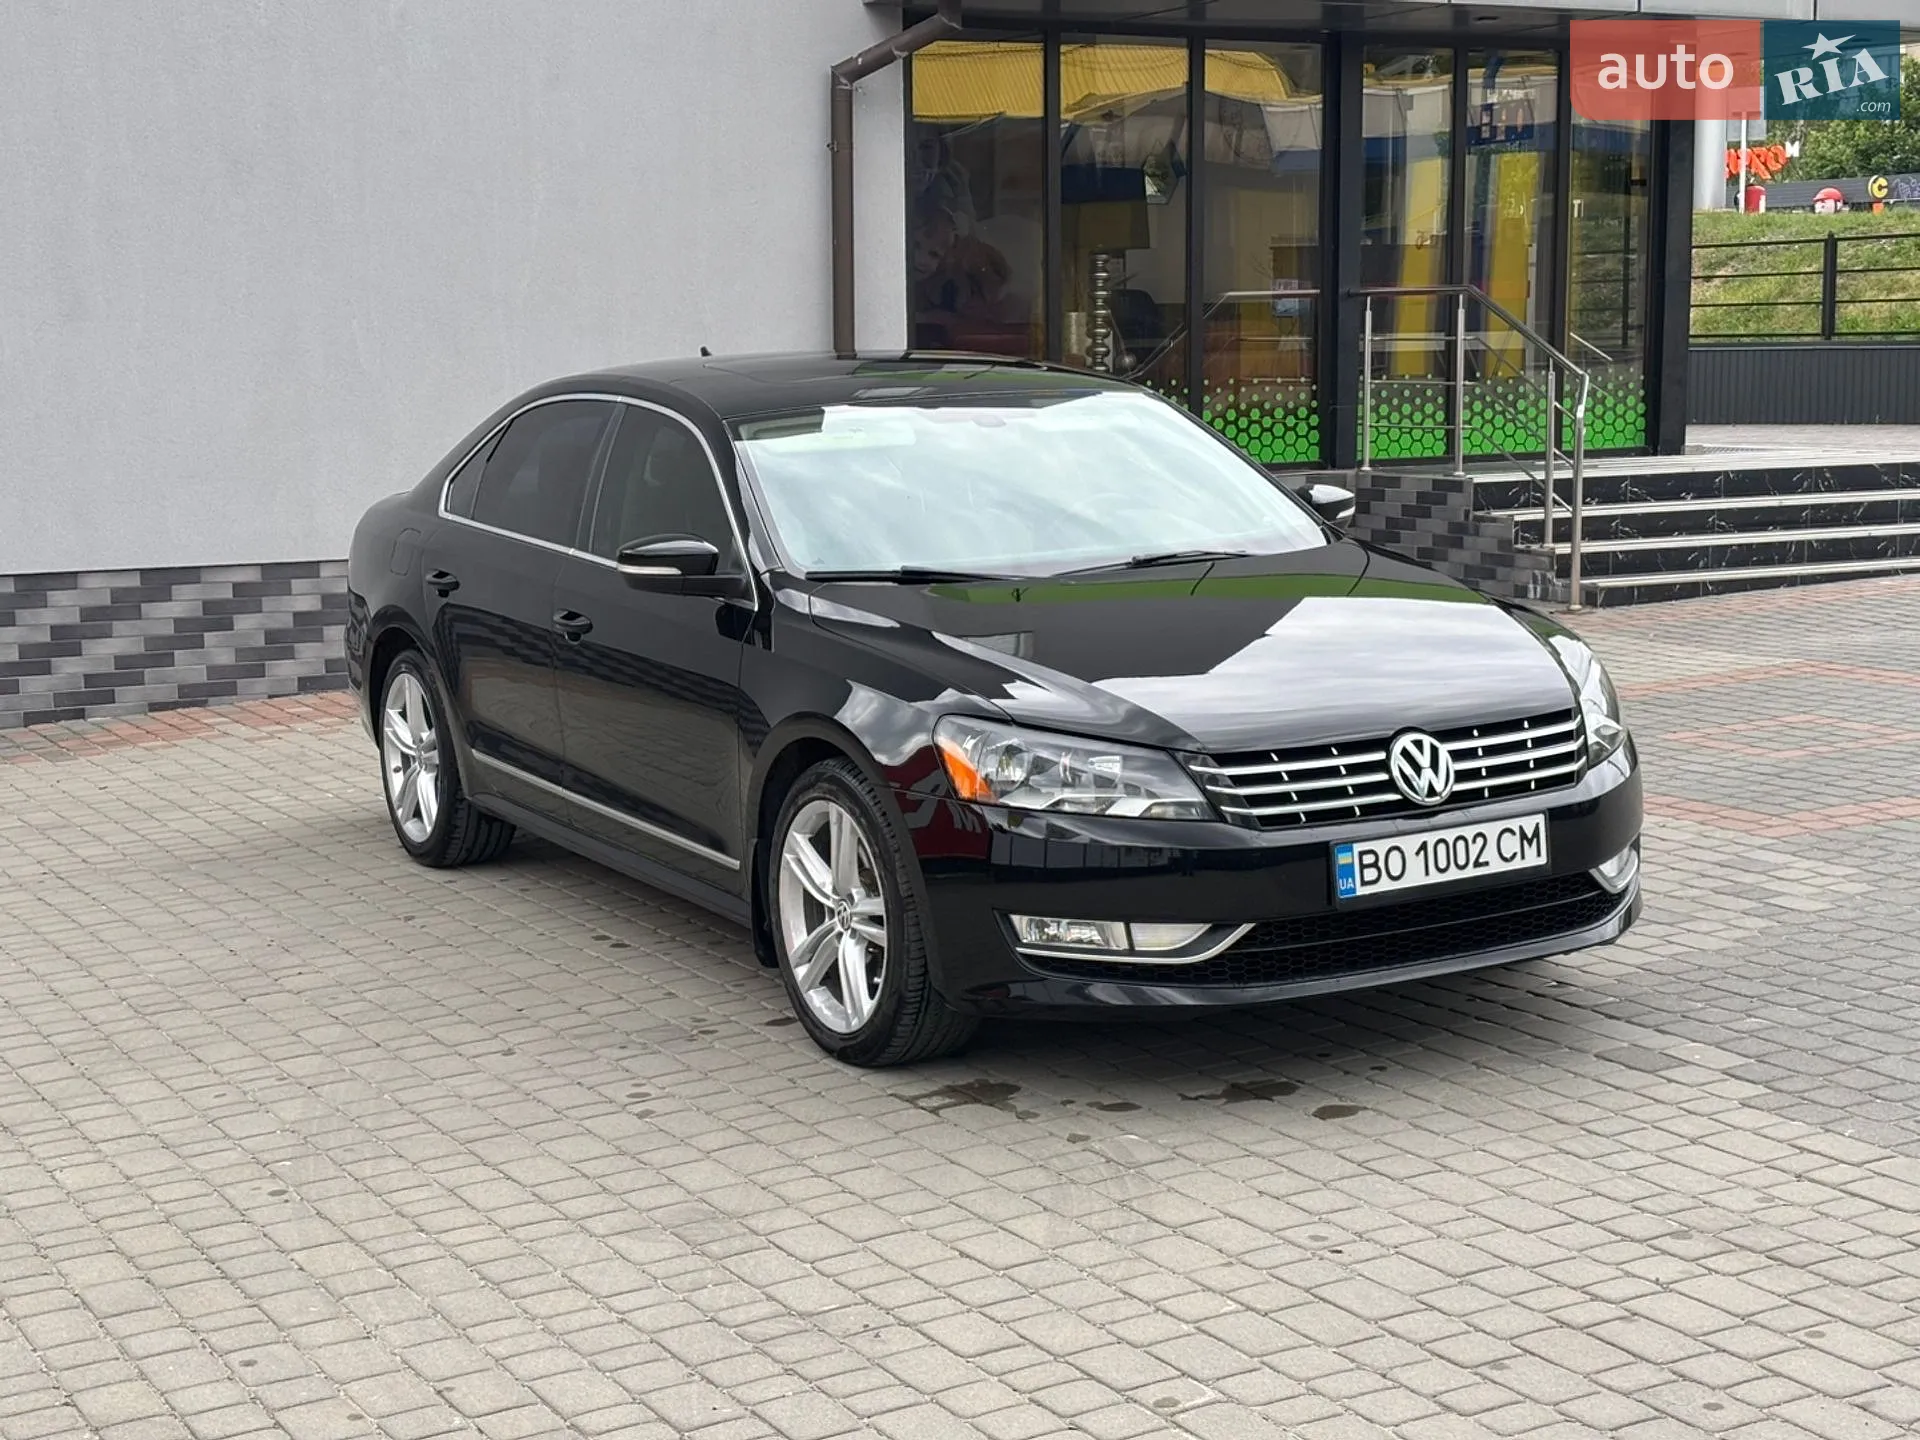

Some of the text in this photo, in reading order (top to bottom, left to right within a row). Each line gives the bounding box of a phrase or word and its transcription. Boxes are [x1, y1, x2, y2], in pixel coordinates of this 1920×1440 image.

[1358, 822, 1542, 888] BO 1002 CM
[1339, 877, 1355, 890] UA
